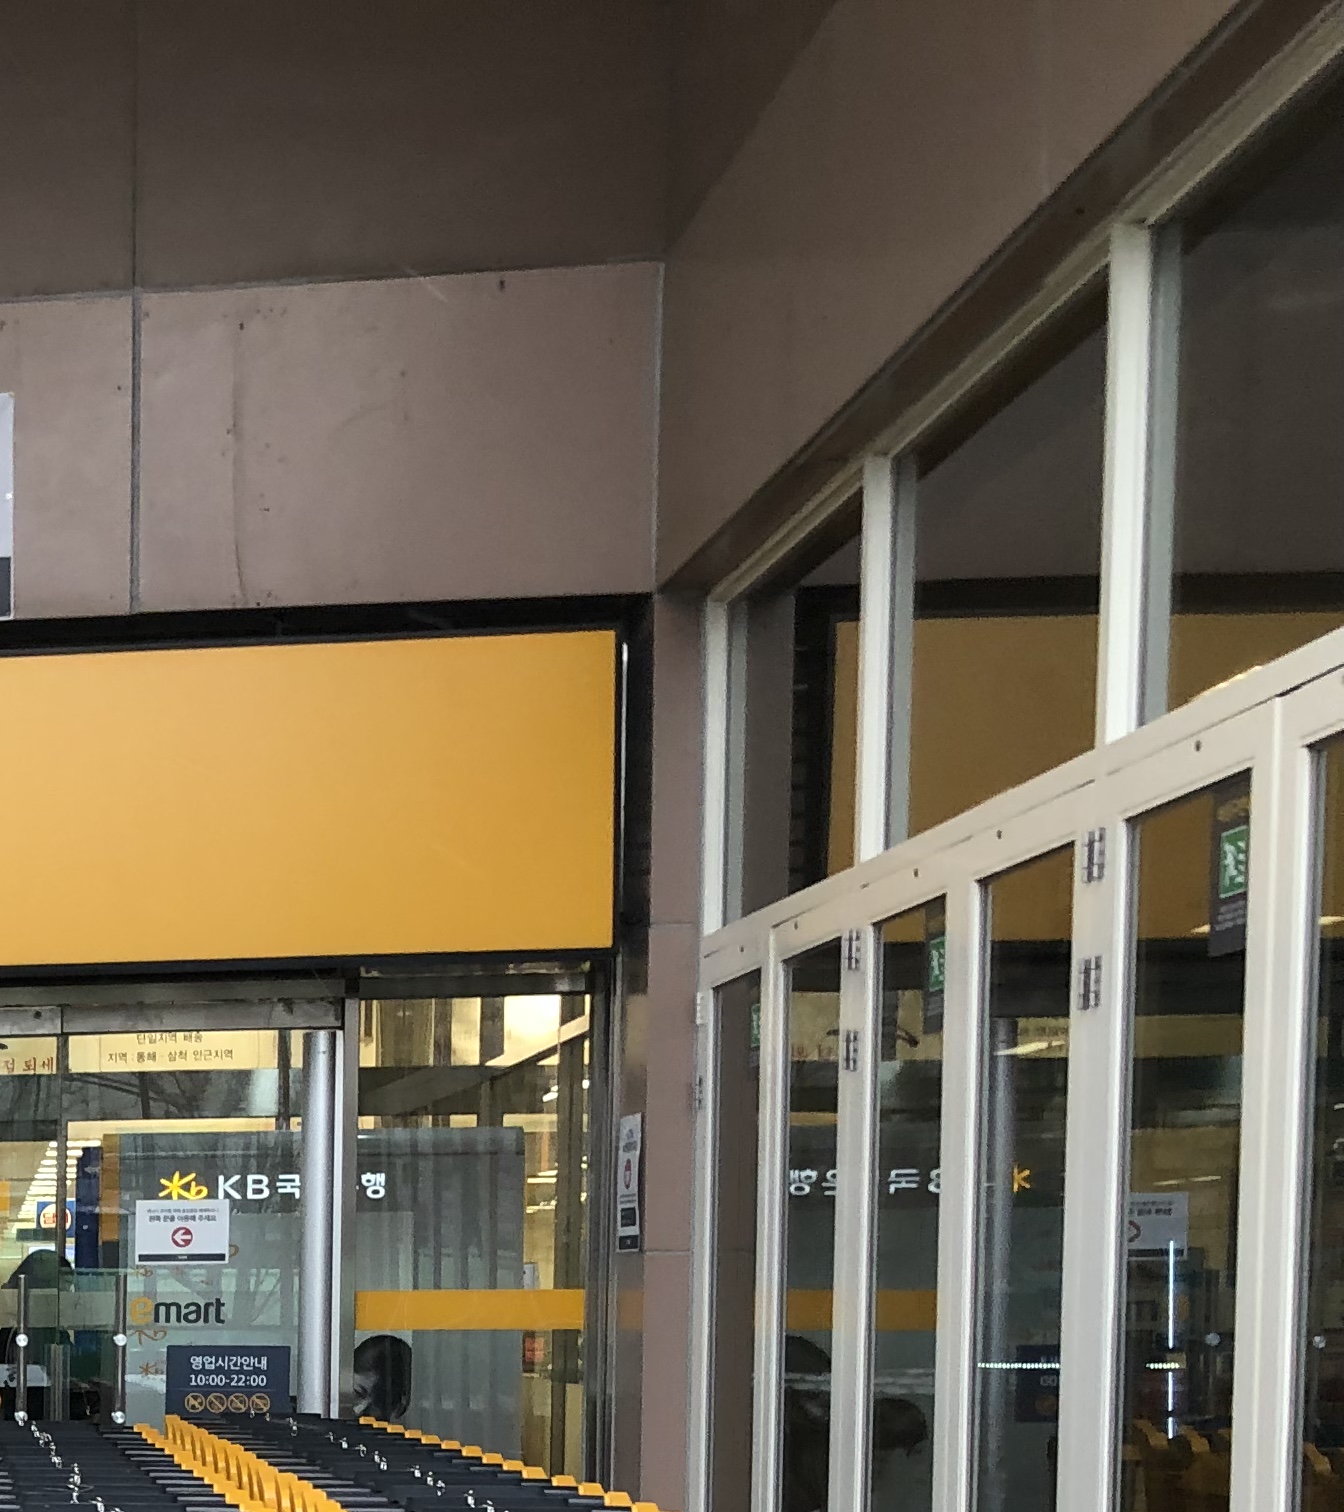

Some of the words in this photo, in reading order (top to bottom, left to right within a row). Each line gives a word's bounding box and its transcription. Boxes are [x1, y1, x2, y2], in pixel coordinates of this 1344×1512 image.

[217, 1171, 386, 1200] KB국행
[129, 1297, 227, 1325] emart
[189, 1353, 268, 1371] 영업시간안내
[189, 1373, 267, 1387] 10:00-22:00
